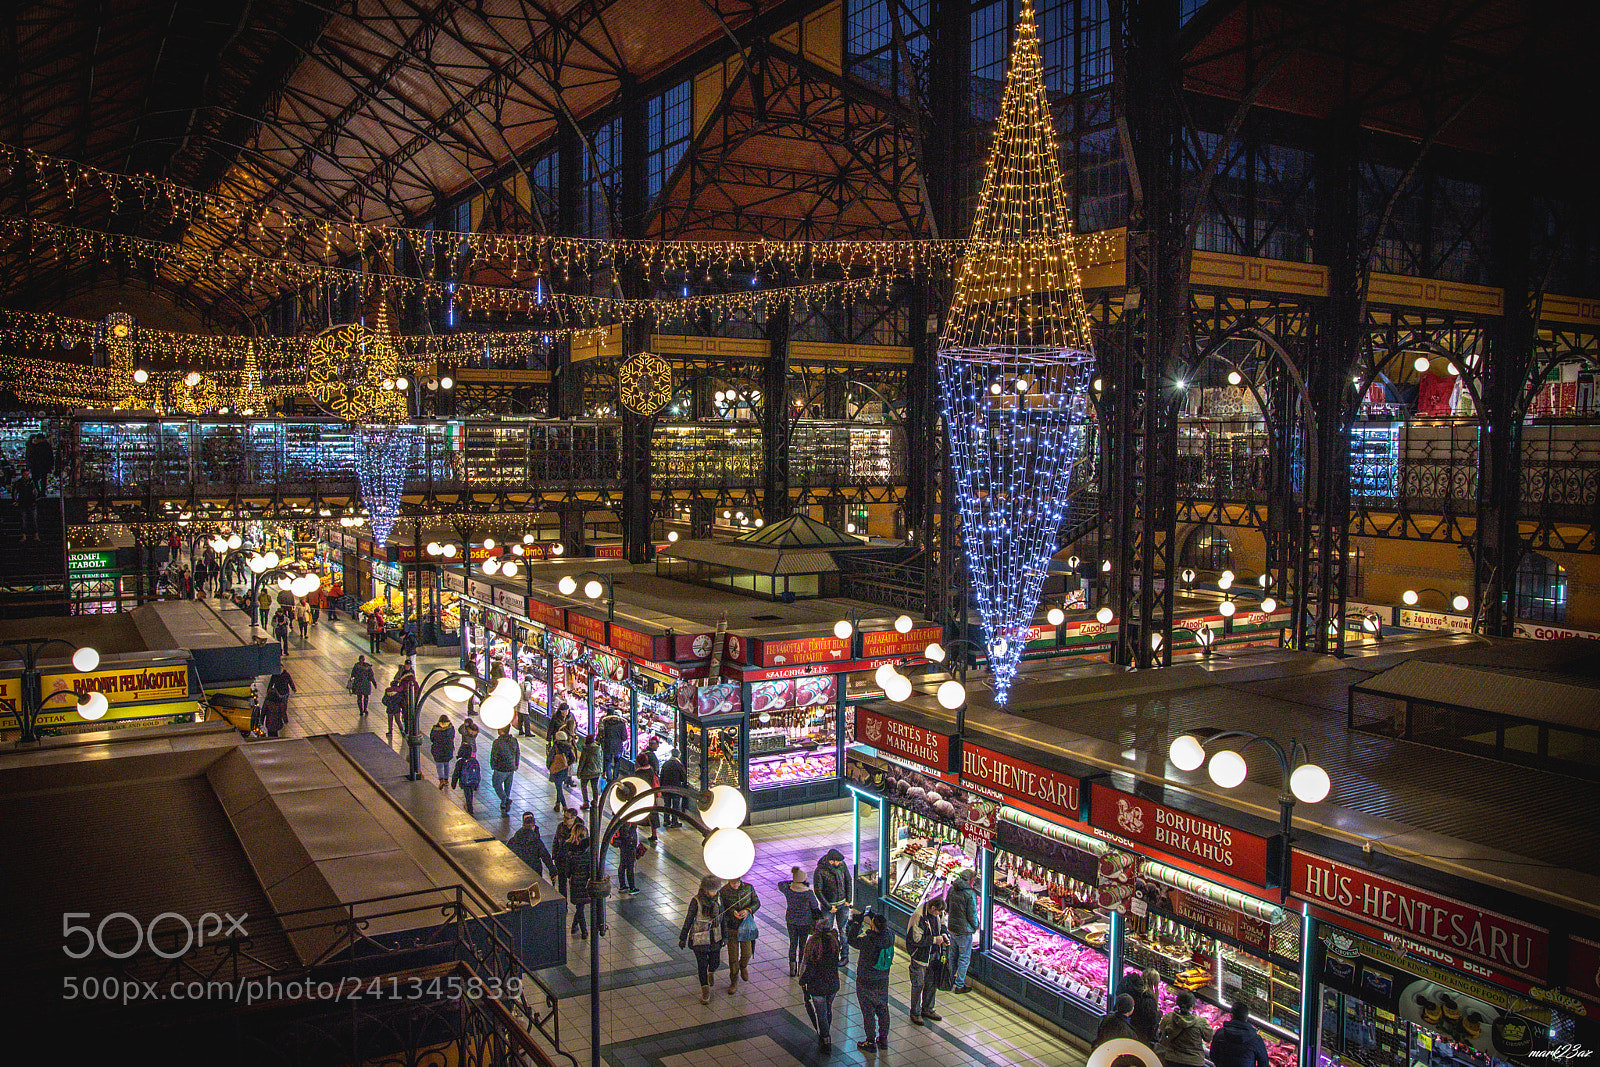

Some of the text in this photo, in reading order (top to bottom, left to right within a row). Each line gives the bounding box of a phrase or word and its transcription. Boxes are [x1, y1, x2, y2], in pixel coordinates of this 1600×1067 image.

[1013, 628, 1040, 640] ZDOR
[1081, 622, 1106, 634] ZÁDOR
[73, 674, 118, 694] BAROMFI
[119, 669, 187, 693] FELVÁGOTTAK
[887, 721, 938, 748] SERTÉS ÉS
[886, 734, 939, 763] MARHAHÚS
[1155, 808, 1232, 846] BORJUHÚS
[968, 833, 987, 848] SHOP
[1155, 826, 1234, 867] BIRKAHÚS
[1178, 905, 1206, 925] SALAMI
[1207, 918, 1214, 927] &
[1216, 920, 1234, 936] HAM
[1463, 960, 1494, 977] BEEF
